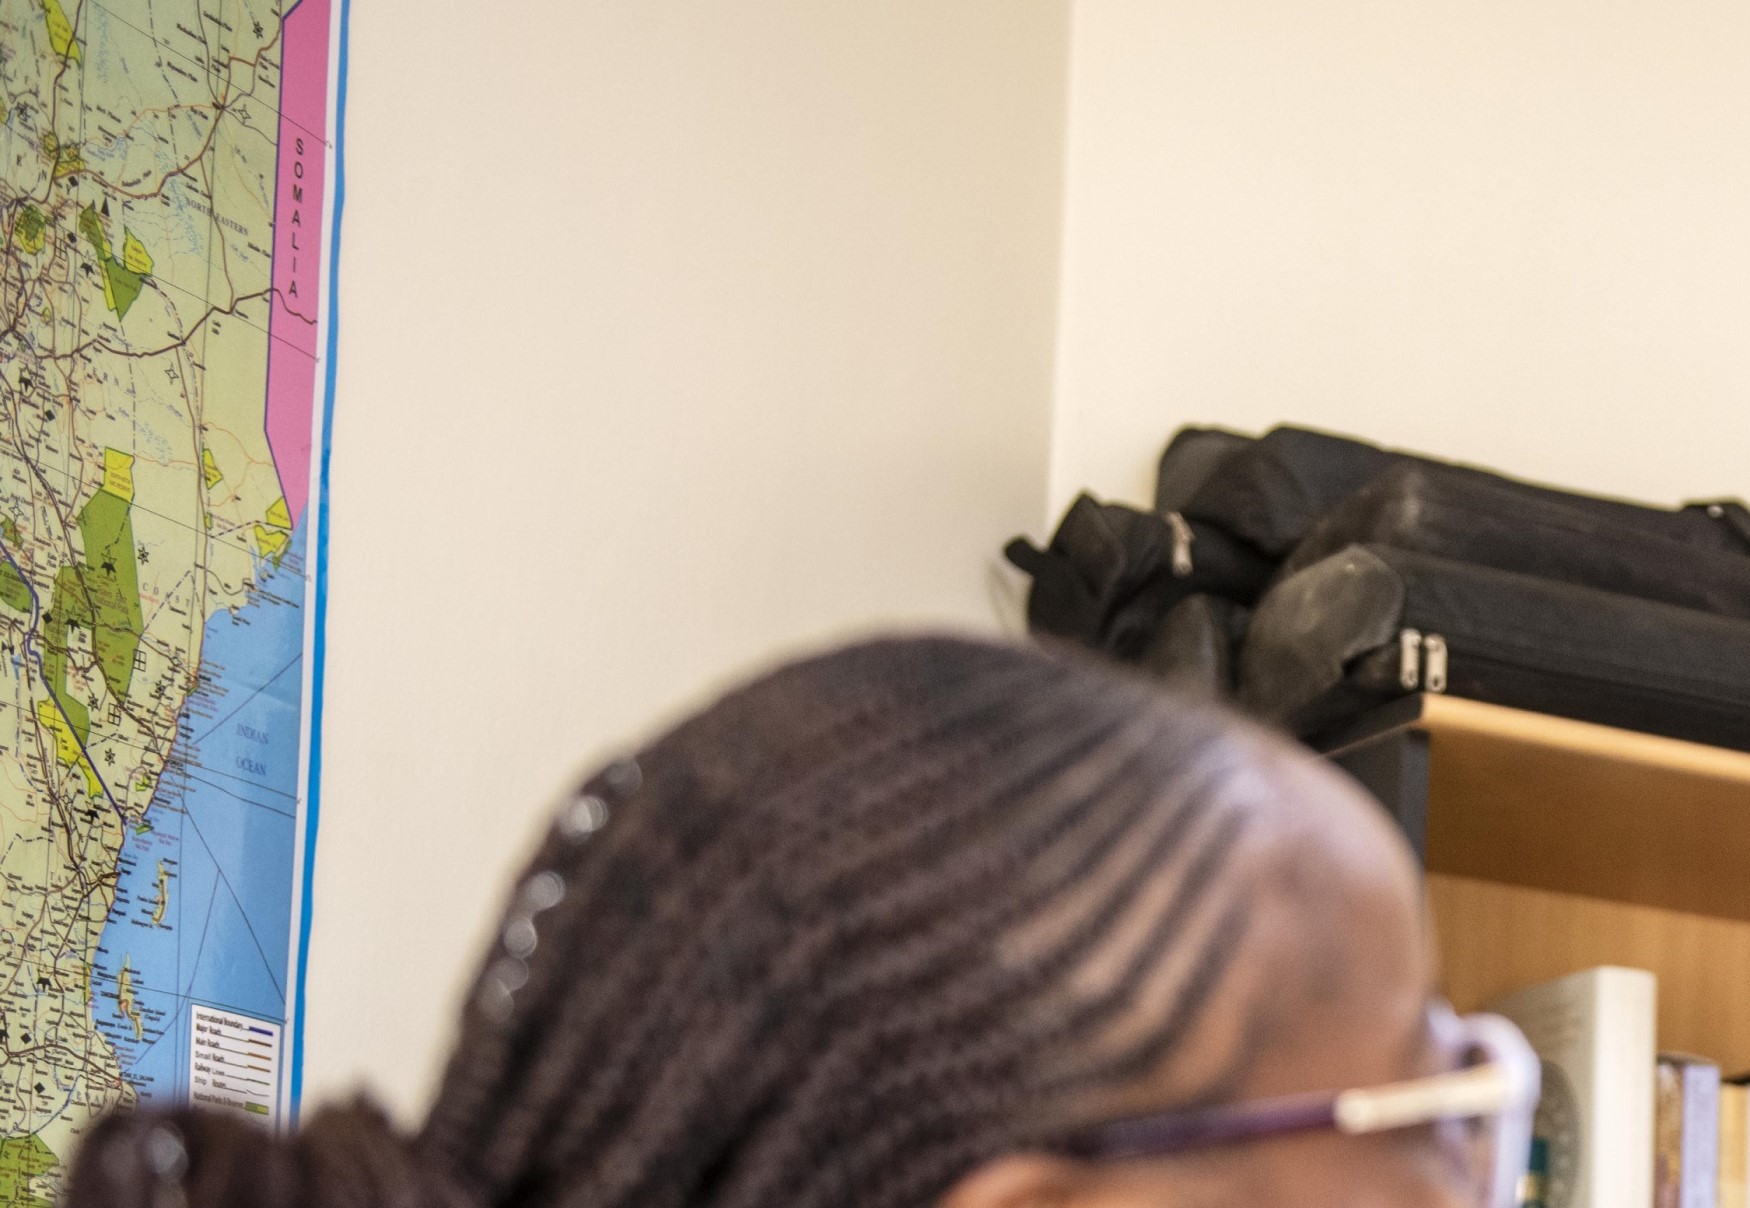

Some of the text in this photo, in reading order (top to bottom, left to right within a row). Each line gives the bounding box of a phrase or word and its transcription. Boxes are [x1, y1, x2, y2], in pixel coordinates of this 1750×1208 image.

[289, 138, 304, 298] SOMALIA
[237, 723, 269, 745] INDIAN
[236, 756, 267, 776] OCEAN
